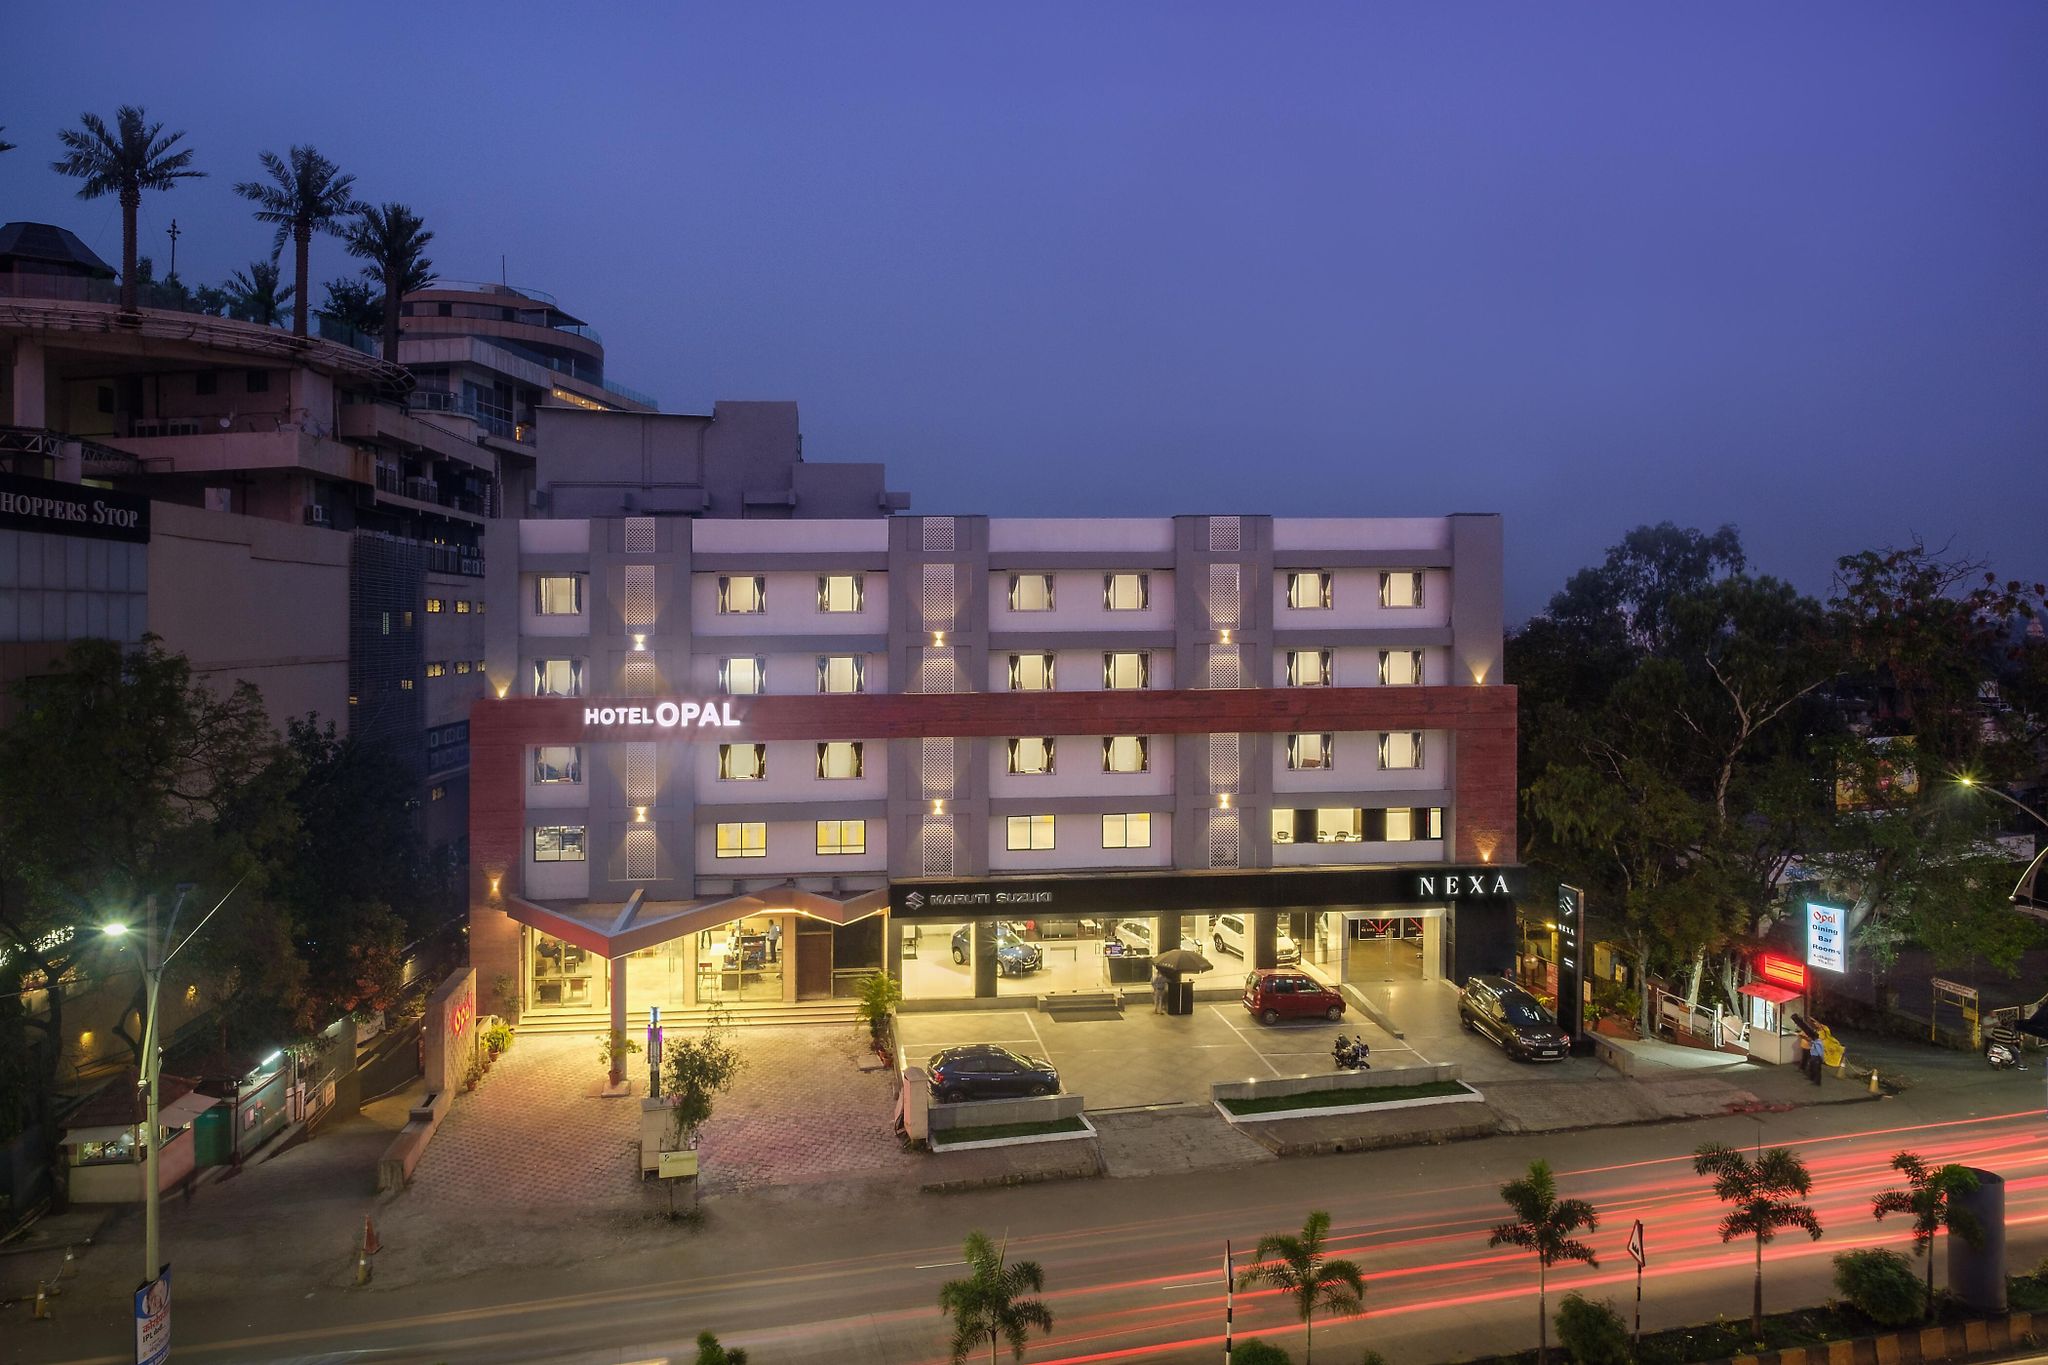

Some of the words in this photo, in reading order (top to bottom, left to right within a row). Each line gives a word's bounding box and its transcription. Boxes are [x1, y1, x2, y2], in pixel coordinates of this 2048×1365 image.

[93, 500, 138, 528] STOP
[585, 707, 654, 725] HOTEL
[656, 702, 740, 727] OPAL
[1420, 875, 1510, 895] NEXA
[930, 894, 990, 905] MARUTI
[996, 892, 1053, 904] SUZUKI
[1813, 911, 1836, 924] Opal
[1812, 924, 1838, 936] Dining
[1818, 935, 1832, 944] Bar
